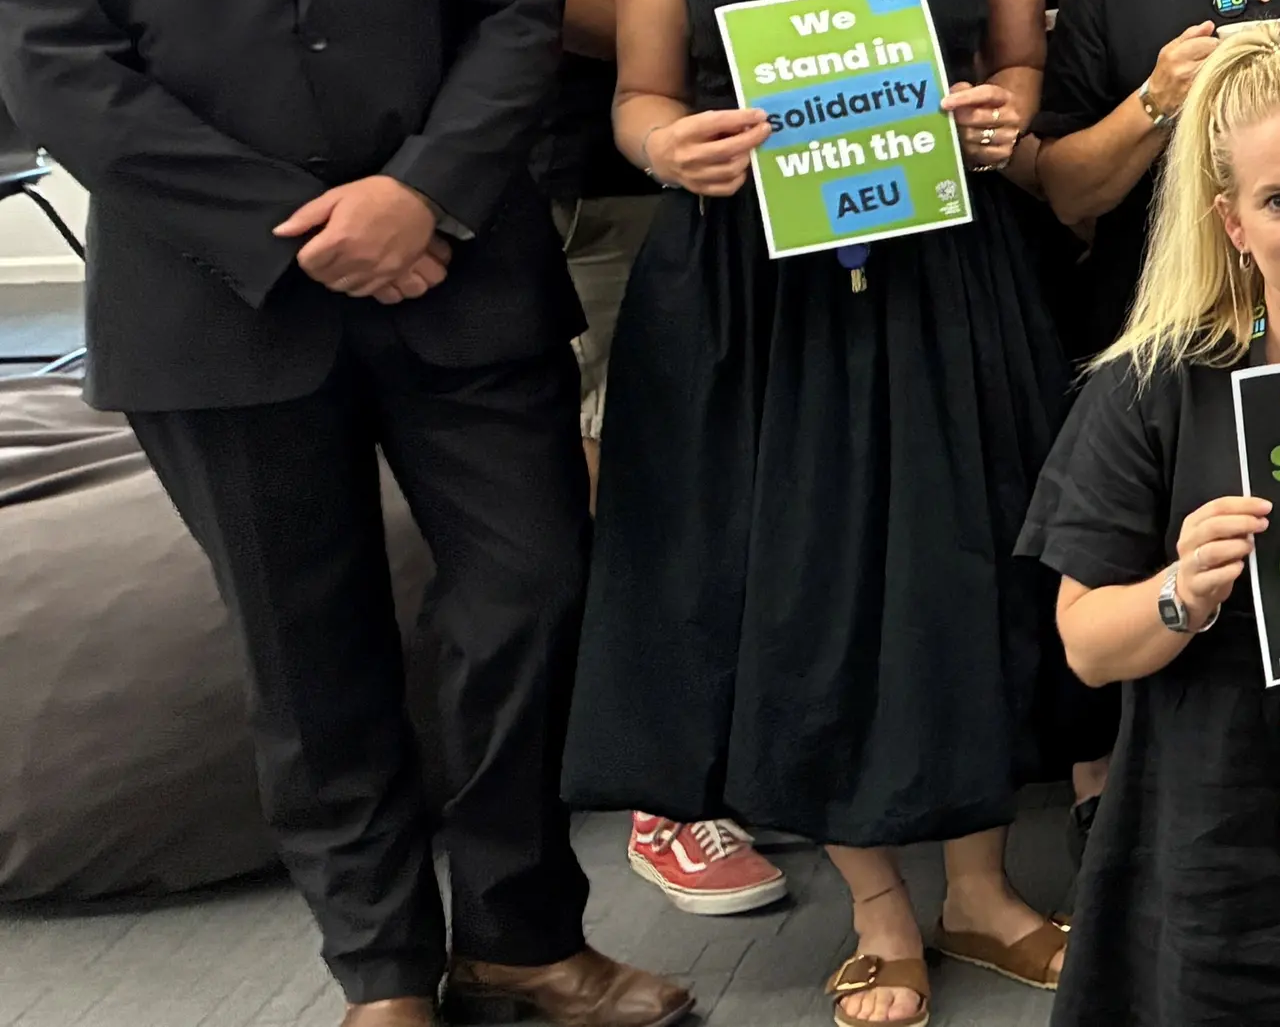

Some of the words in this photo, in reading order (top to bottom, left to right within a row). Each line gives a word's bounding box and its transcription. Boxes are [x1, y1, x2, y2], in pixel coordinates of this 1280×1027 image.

[789, 10, 856, 36] We
[754, 42, 868, 84] stand
[873, 38, 913, 65] in
[767, 80, 928, 133] solidarity
[775, 138, 866, 178] with
[870, 130, 935, 162] the
[837, 181, 900, 219] AEU
